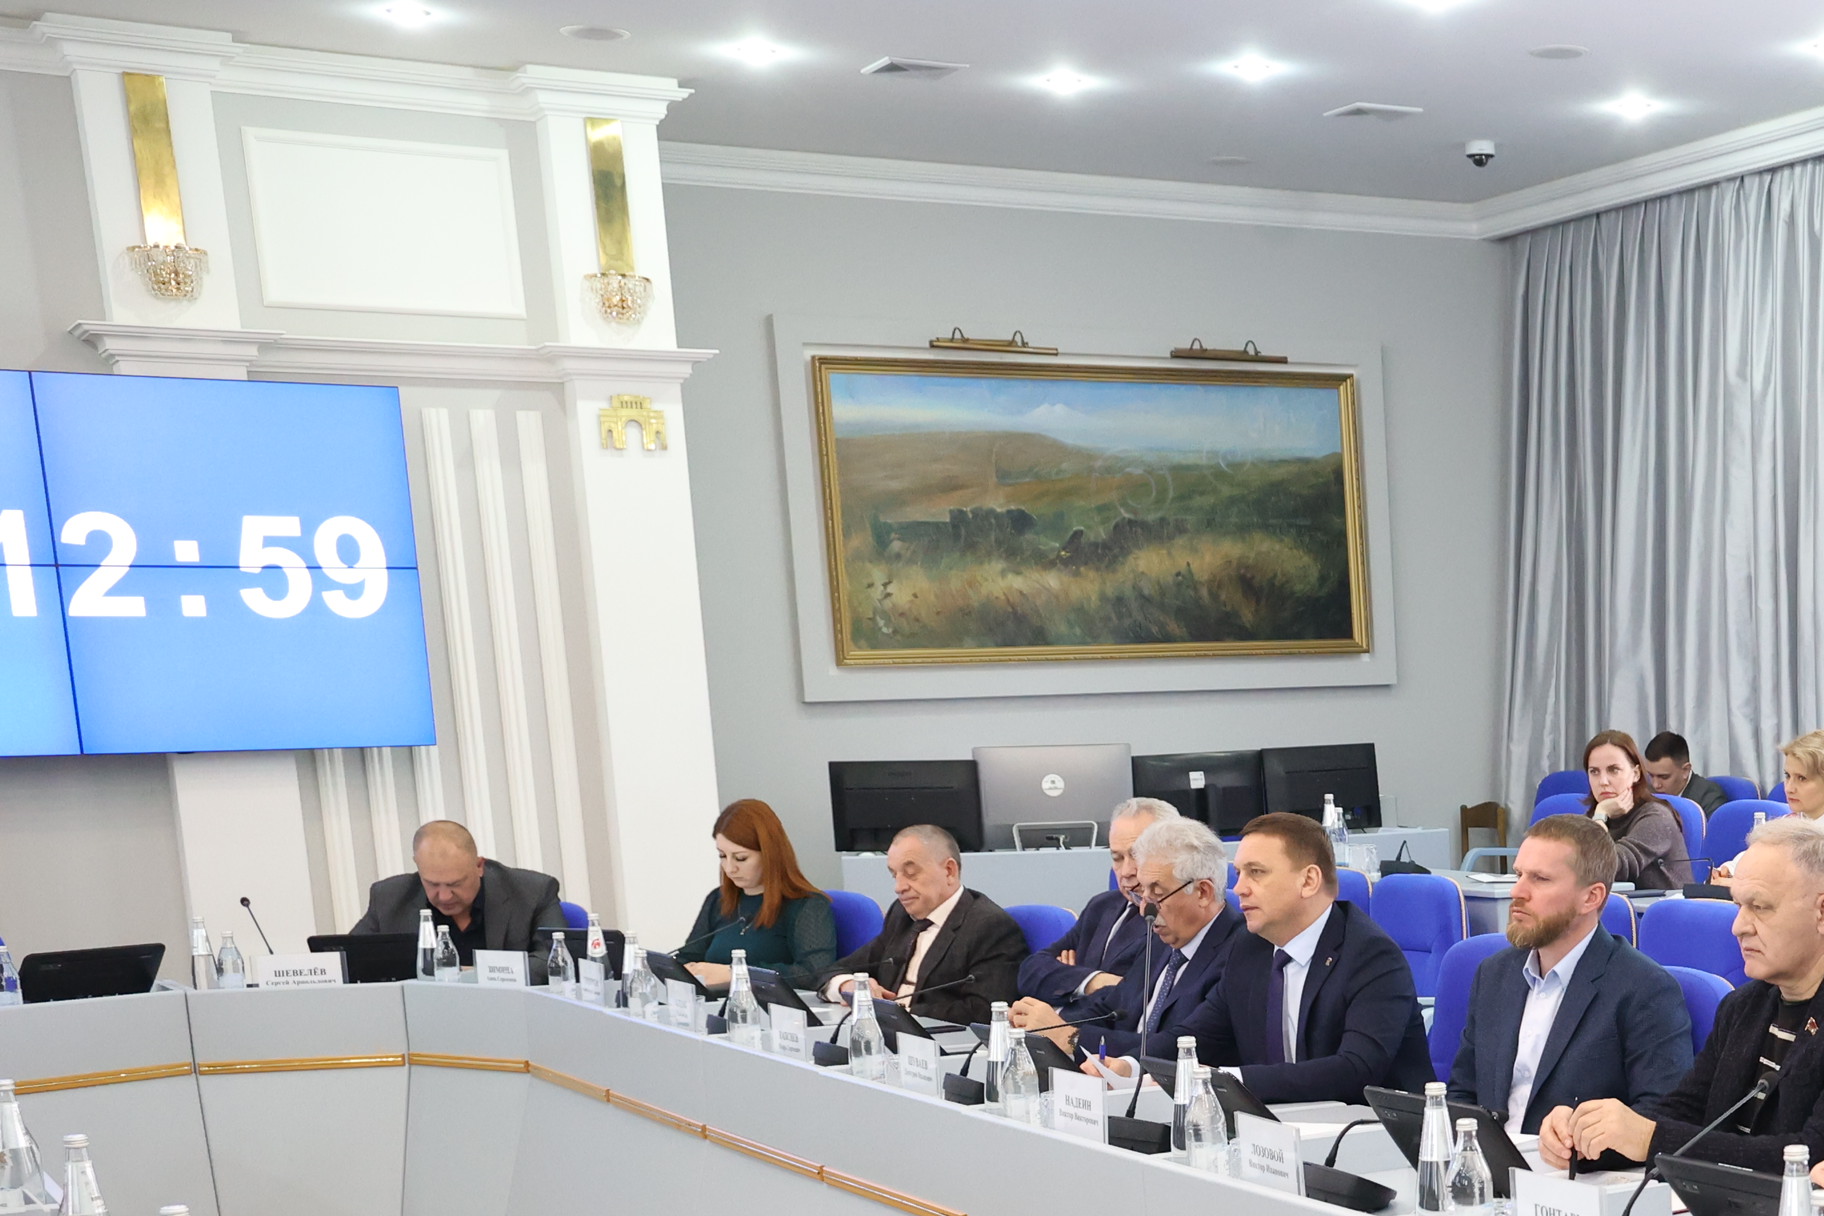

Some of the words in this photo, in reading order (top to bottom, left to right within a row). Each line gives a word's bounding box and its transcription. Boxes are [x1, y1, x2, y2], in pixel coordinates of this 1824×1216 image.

[0, 509, 389, 619] 12:59
[274, 967, 327, 978] ШЕВЕЛЁВ
[1251, 1143, 1285, 1164] ЛОЗОВОЙ
